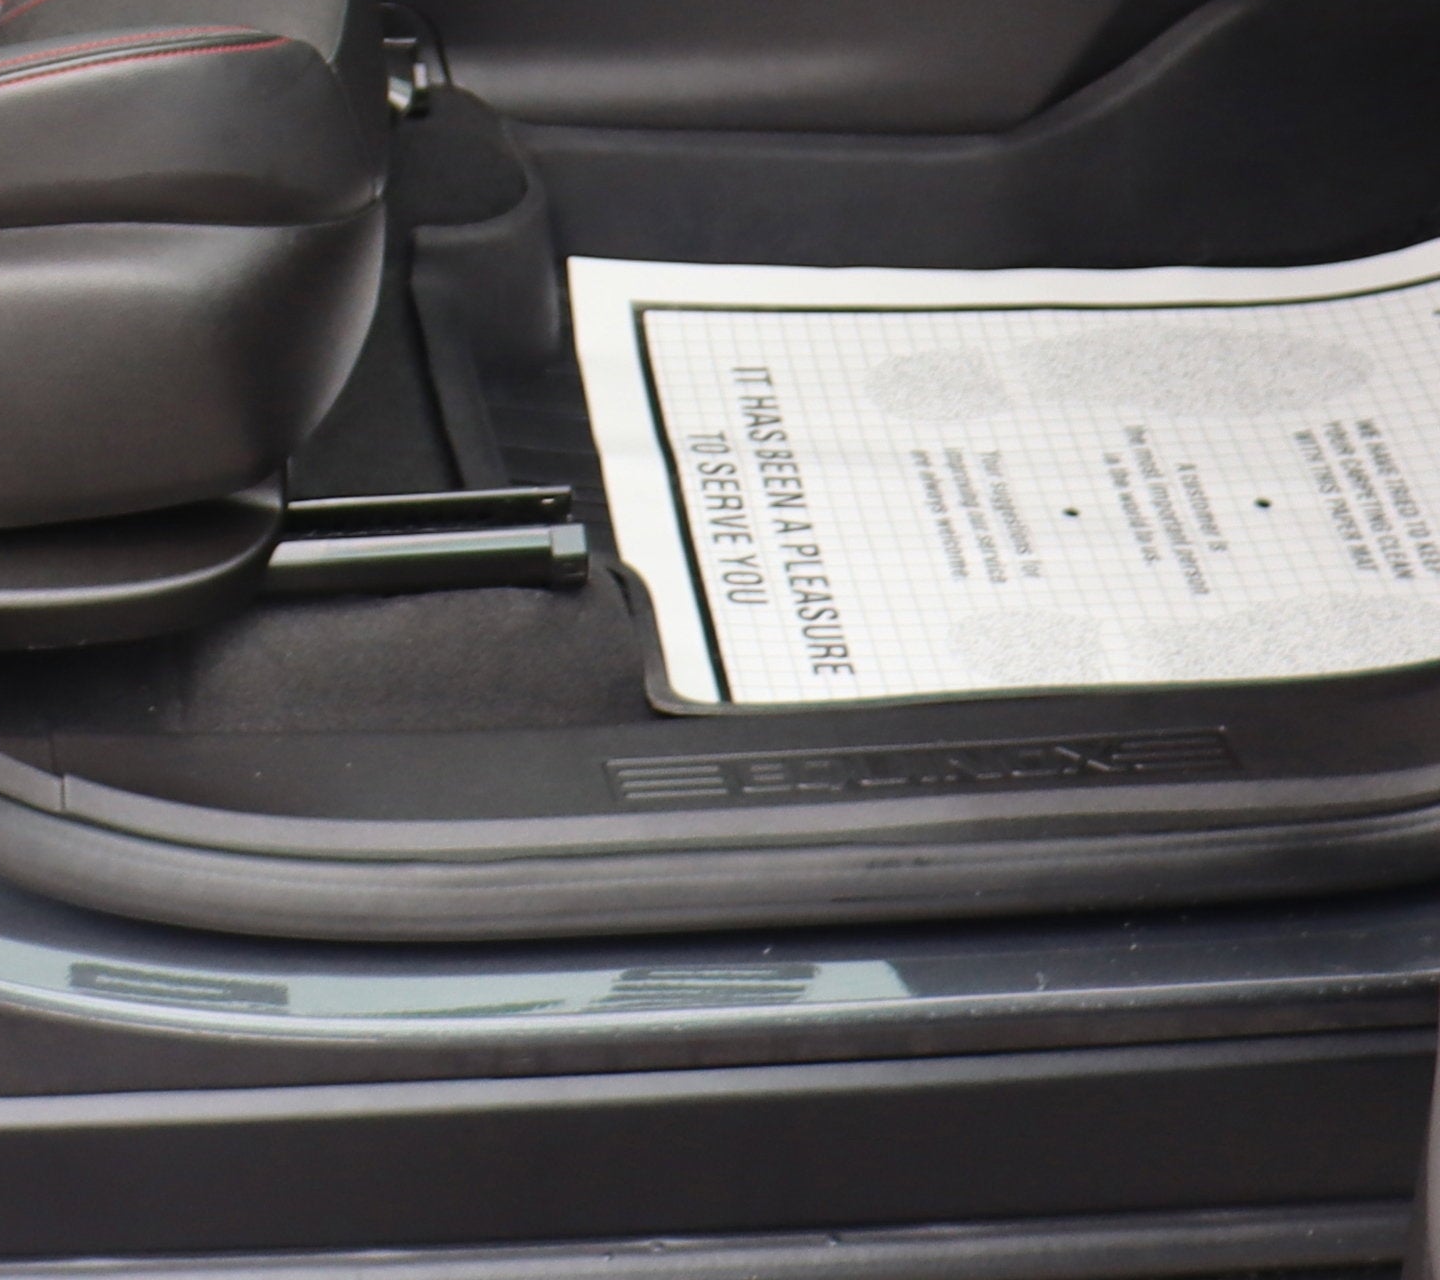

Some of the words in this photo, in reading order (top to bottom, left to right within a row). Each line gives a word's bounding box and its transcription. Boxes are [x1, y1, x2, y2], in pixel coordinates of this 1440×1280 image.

[731, 365, 773, 388] IT
[687, 429, 731, 456] TO
[737, 394, 788, 444] HAS
[695, 461, 754, 545] SERVE
[753, 447, 809, 510] BEEN
[770, 517, 814, 535] A
[1404, 520, 1432, 539] TO
[719, 554, 770, 606] YOU
[779, 544, 856, 676] PLEASURE
